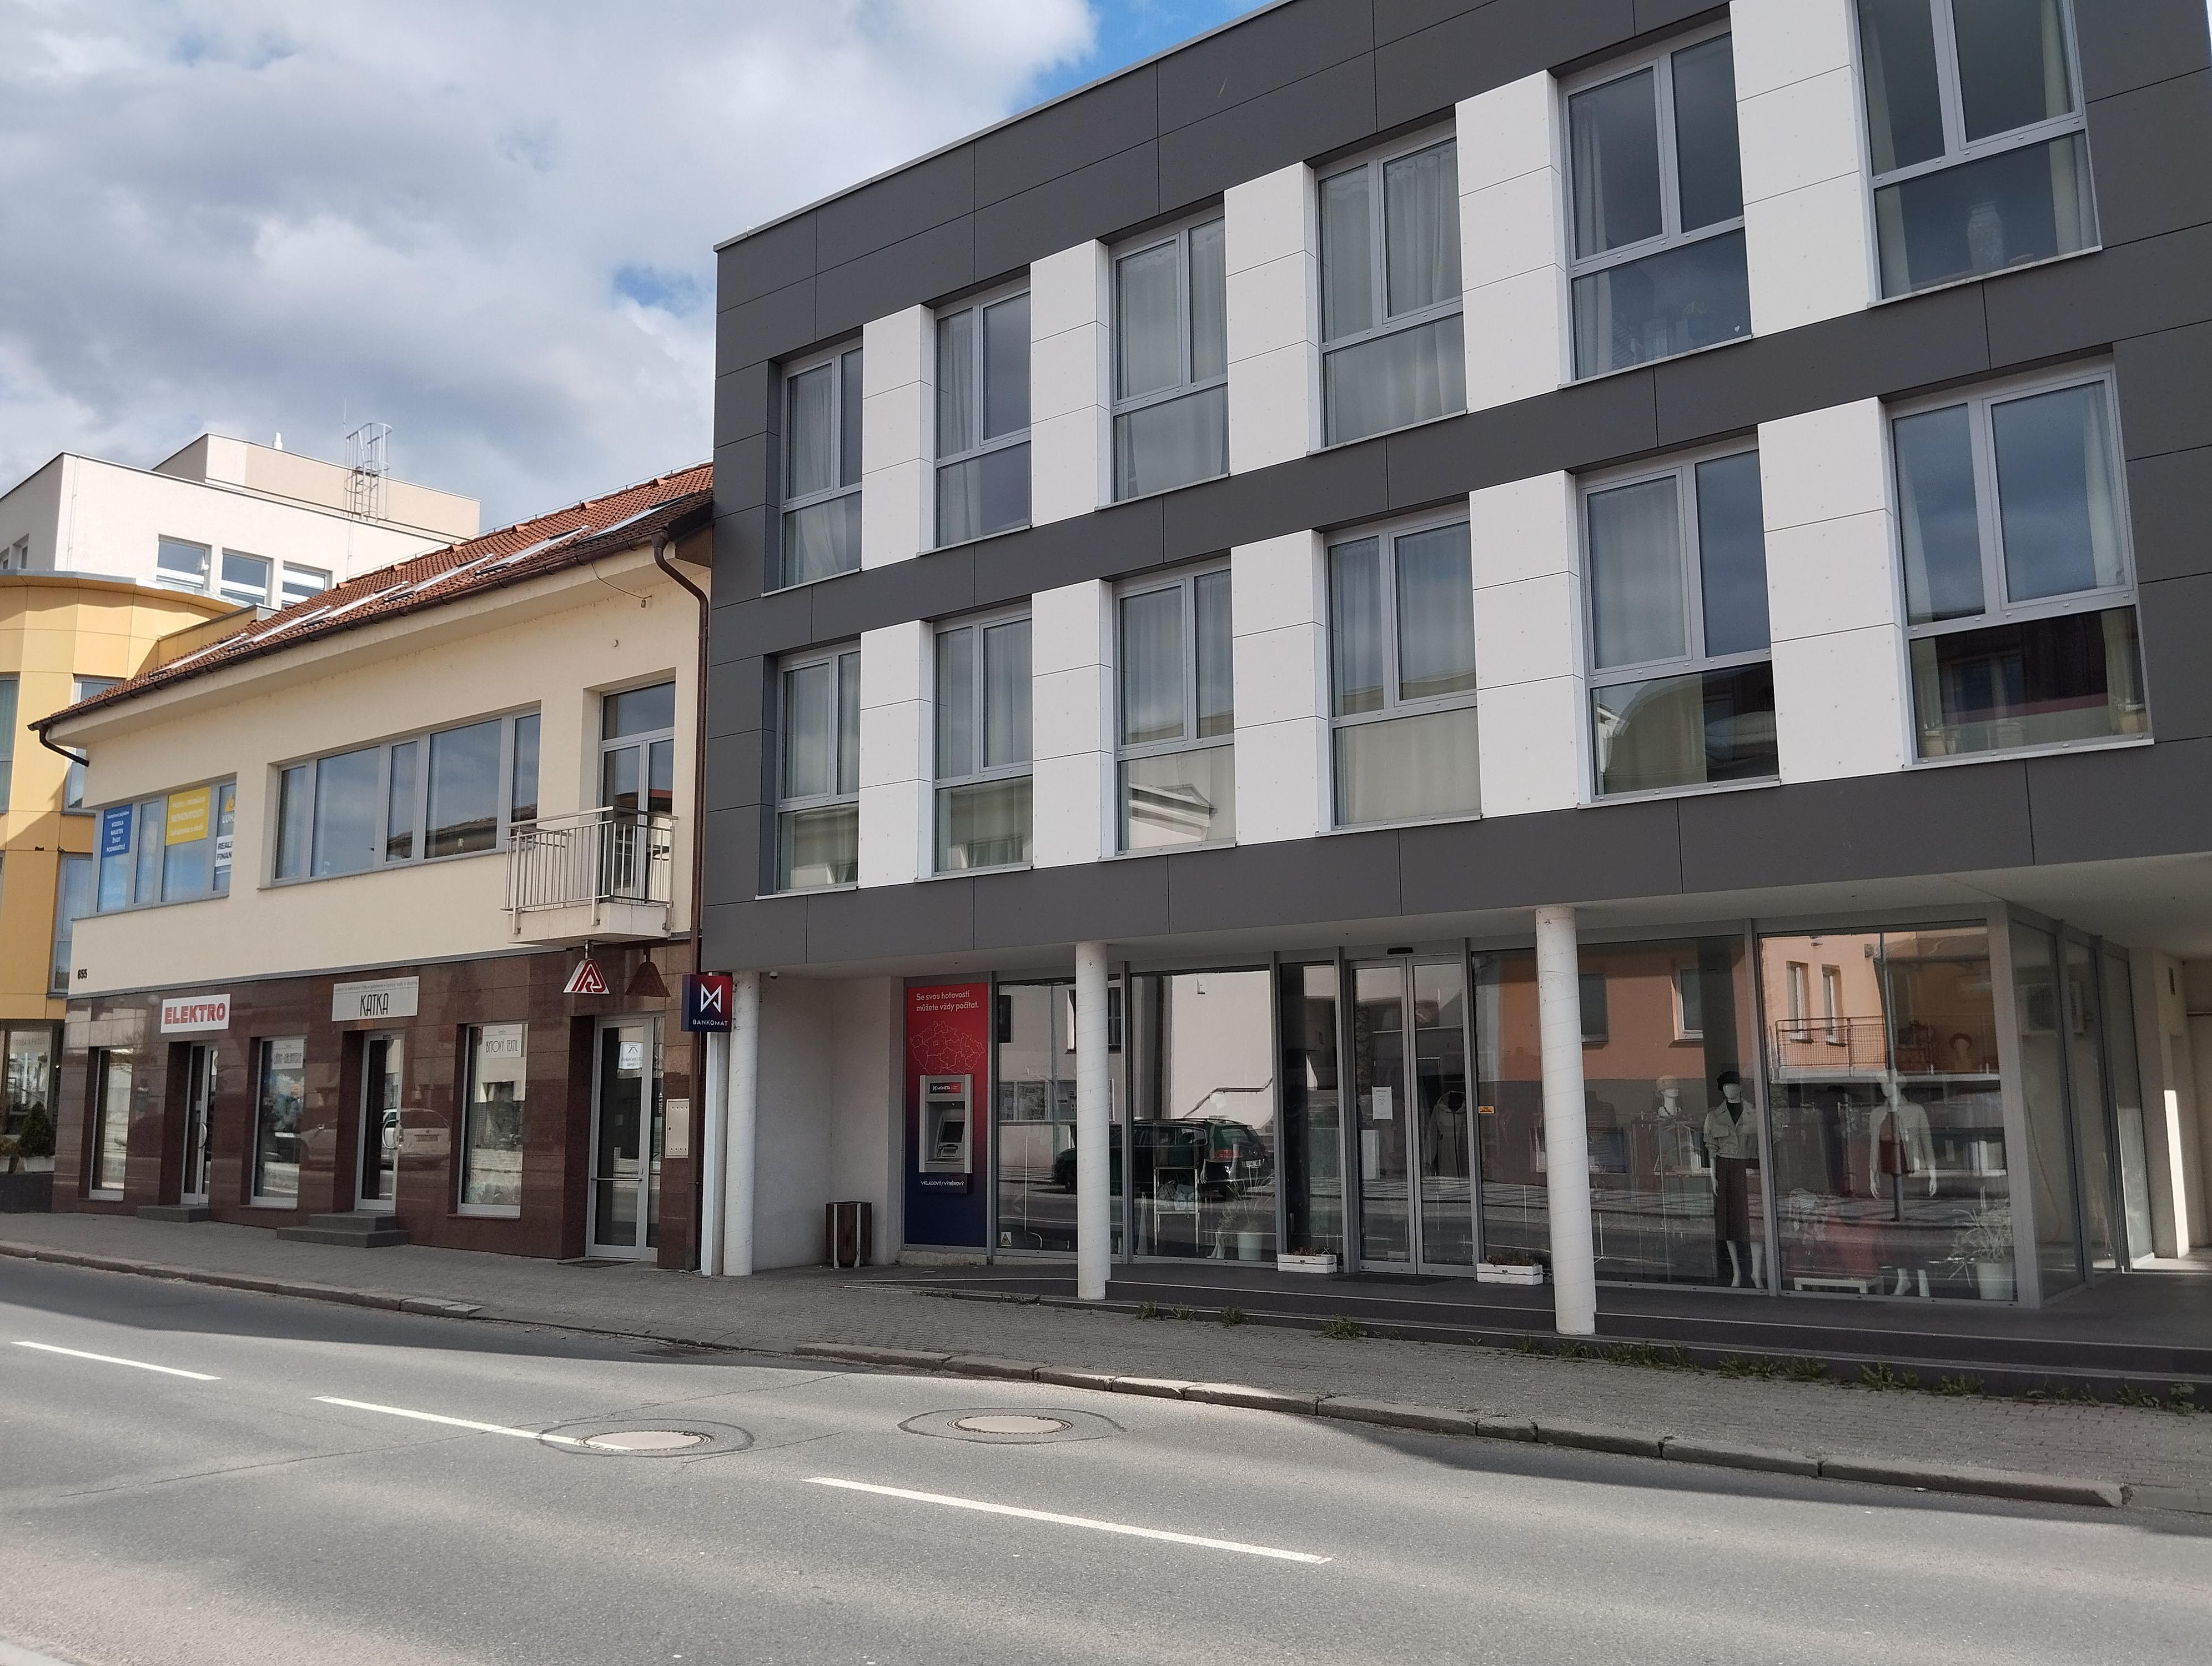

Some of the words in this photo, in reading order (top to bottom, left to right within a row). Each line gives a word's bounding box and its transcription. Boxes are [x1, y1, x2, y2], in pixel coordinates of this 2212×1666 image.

[77, 969, 88, 980] 655
[941, 990, 971, 1000] hotovostí
[360, 993, 389, 1016] KATKA
[939, 1002, 954, 1012] vždy
[956, 1001, 979, 1012] počítat.
[164, 1003, 225, 1025] ELEKTRO
[486, 1038, 505, 1053] BYTOVÝ
